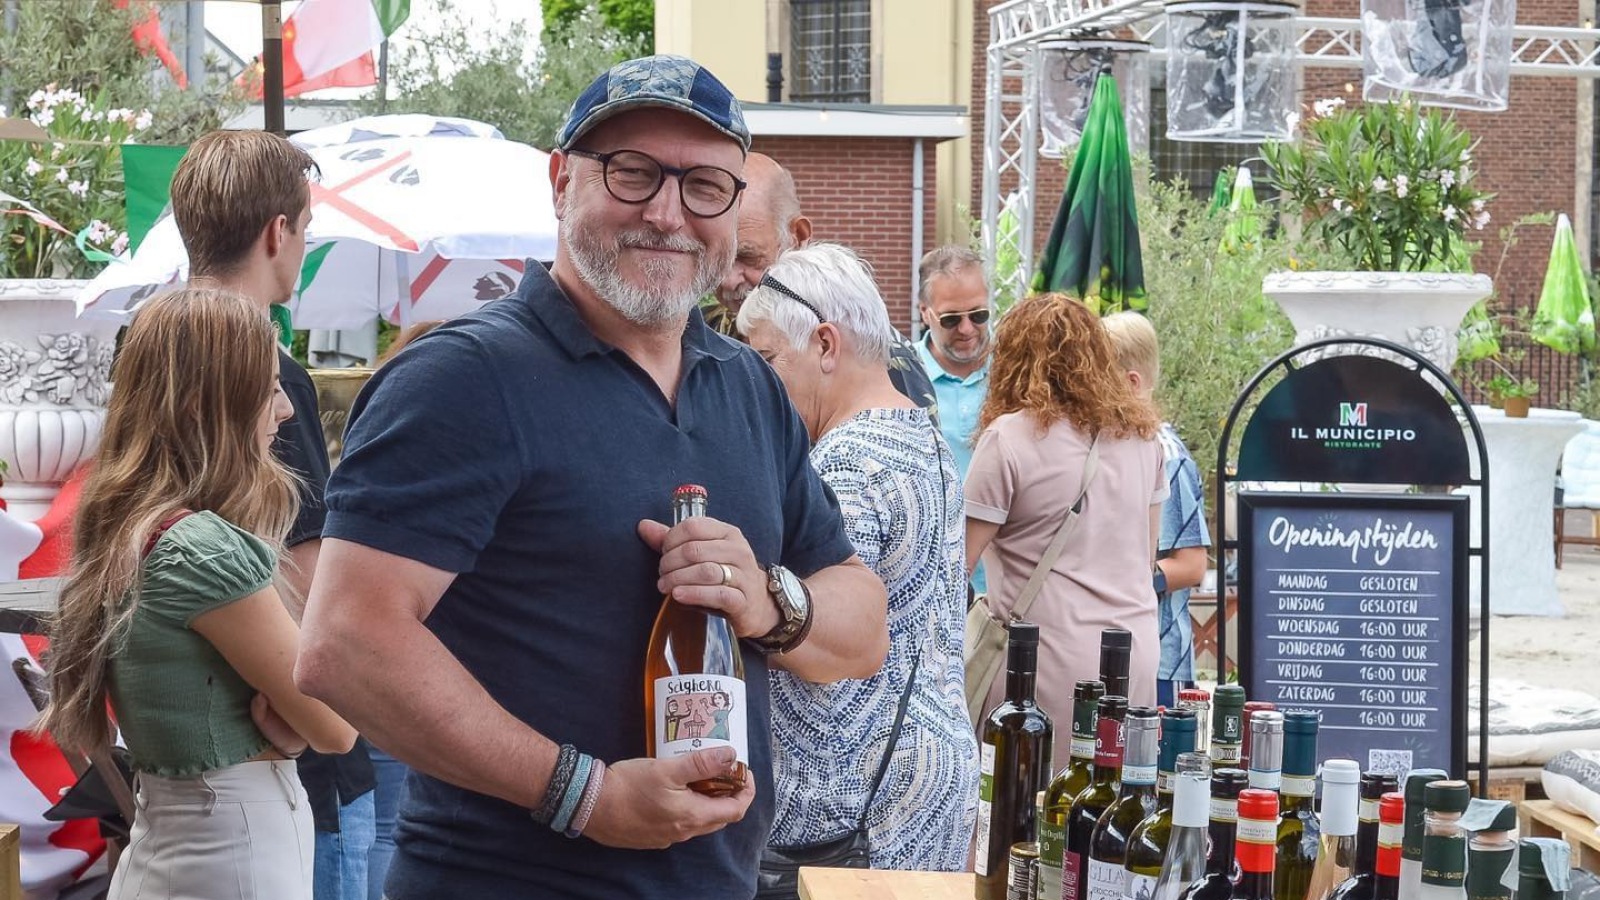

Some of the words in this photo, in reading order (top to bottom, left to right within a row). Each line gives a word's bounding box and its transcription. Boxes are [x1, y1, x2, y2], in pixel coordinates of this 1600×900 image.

[1291, 428, 1308, 439] IL
[1316, 428, 1416, 440] MUNICIPIO
[1324, 441, 1382, 449] RISTORANTE
[1268, 516, 1438, 566] Openingstijden
[1278, 574, 1328, 590] MAANDAG
[1359, 576, 1418, 592] GESLOTEN
[1278, 596, 1325, 612] DINSDAG
[1359, 599, 1418, 614] GESLOTEN
[1278, 619, 1339, 634] WOENSDAG
[1359, 622, 1396, 637] 16:00
[1402, 622, 1427, 637] UUR
[1278, 641, 1345, 657] DONDERDAG
[1359, 644, 1396, 659] 16:00
[1402, 645, 1427, 660] UUR
[1278, 664, 1322, 680] VRIJDAG
[1359, 666, 1396, 681] 16:00
[1401, 667, 1427, 682] UUR
[1278, 686, 1335, 701] ZATERDAG
[1359, 688, 1395, 703] 16:00
[1401, 689, 1426, 705] UUR
[1359, 711, 1395, 726] 16:00
[1401, 712, 1426, 727] UUR
